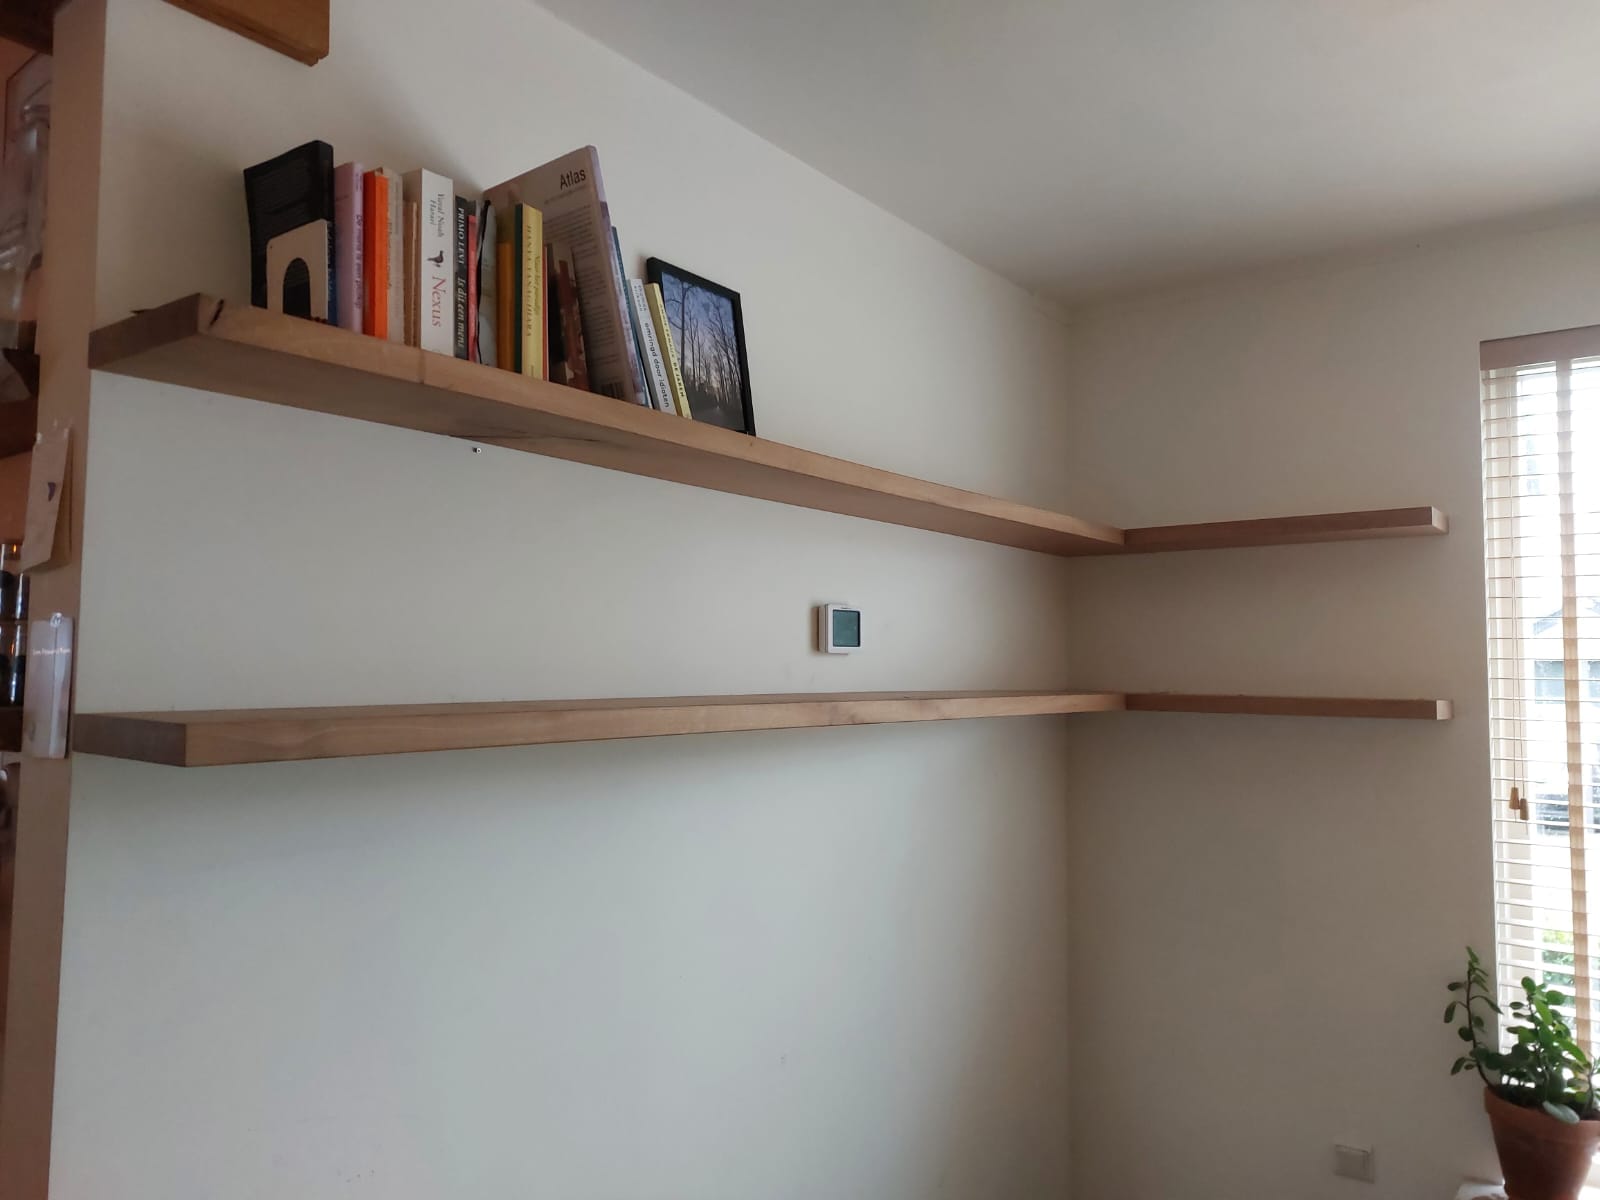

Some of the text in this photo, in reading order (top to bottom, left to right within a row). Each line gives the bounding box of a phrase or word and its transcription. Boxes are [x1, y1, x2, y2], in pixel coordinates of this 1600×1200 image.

[560, 169, 586, 190] Atlas
[429, 200, 437, 226] Harari
[437, 194, 446, 238] Yuval Noah
[432, 276, 447, 328] Nexus
[457, 276, 467, 348] Is dit een mens
[644, 322, 670, 408] omringd door idioten
